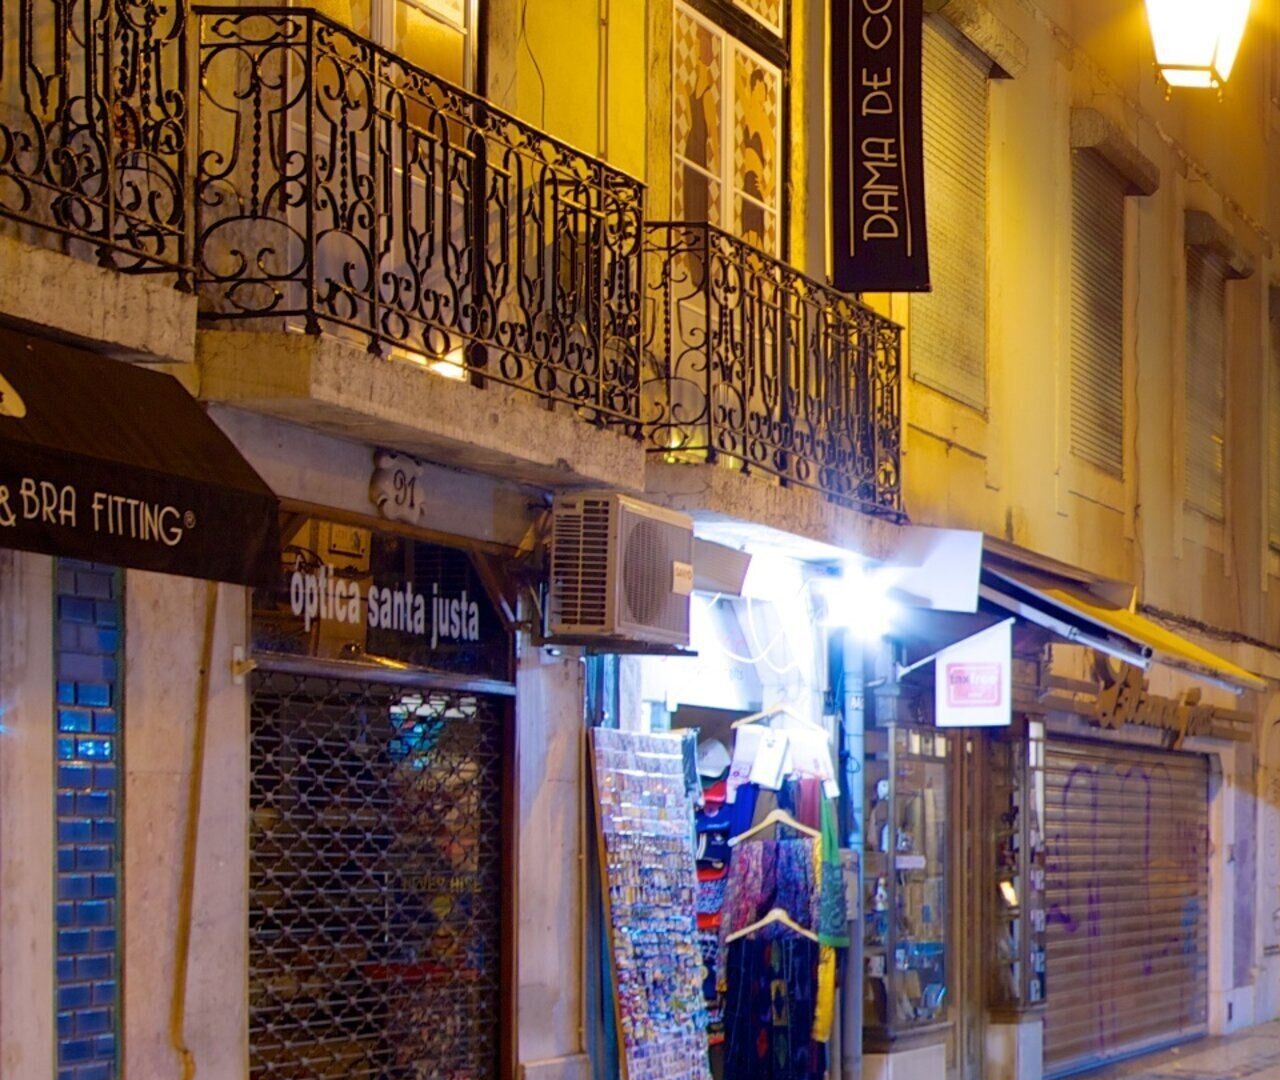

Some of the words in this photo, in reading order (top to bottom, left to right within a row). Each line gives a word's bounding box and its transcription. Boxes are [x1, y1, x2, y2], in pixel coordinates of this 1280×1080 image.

[862, 67, 892, 116] DE
[862, 137, 899, 241] DAMA
[20, 478, 77, 527] BRA
[393, 469, 418, 508] 91
[290, 554, 361, 633] óptica
[367, 581, 426, 636] santa
[430, 582, 480, 650] justa
